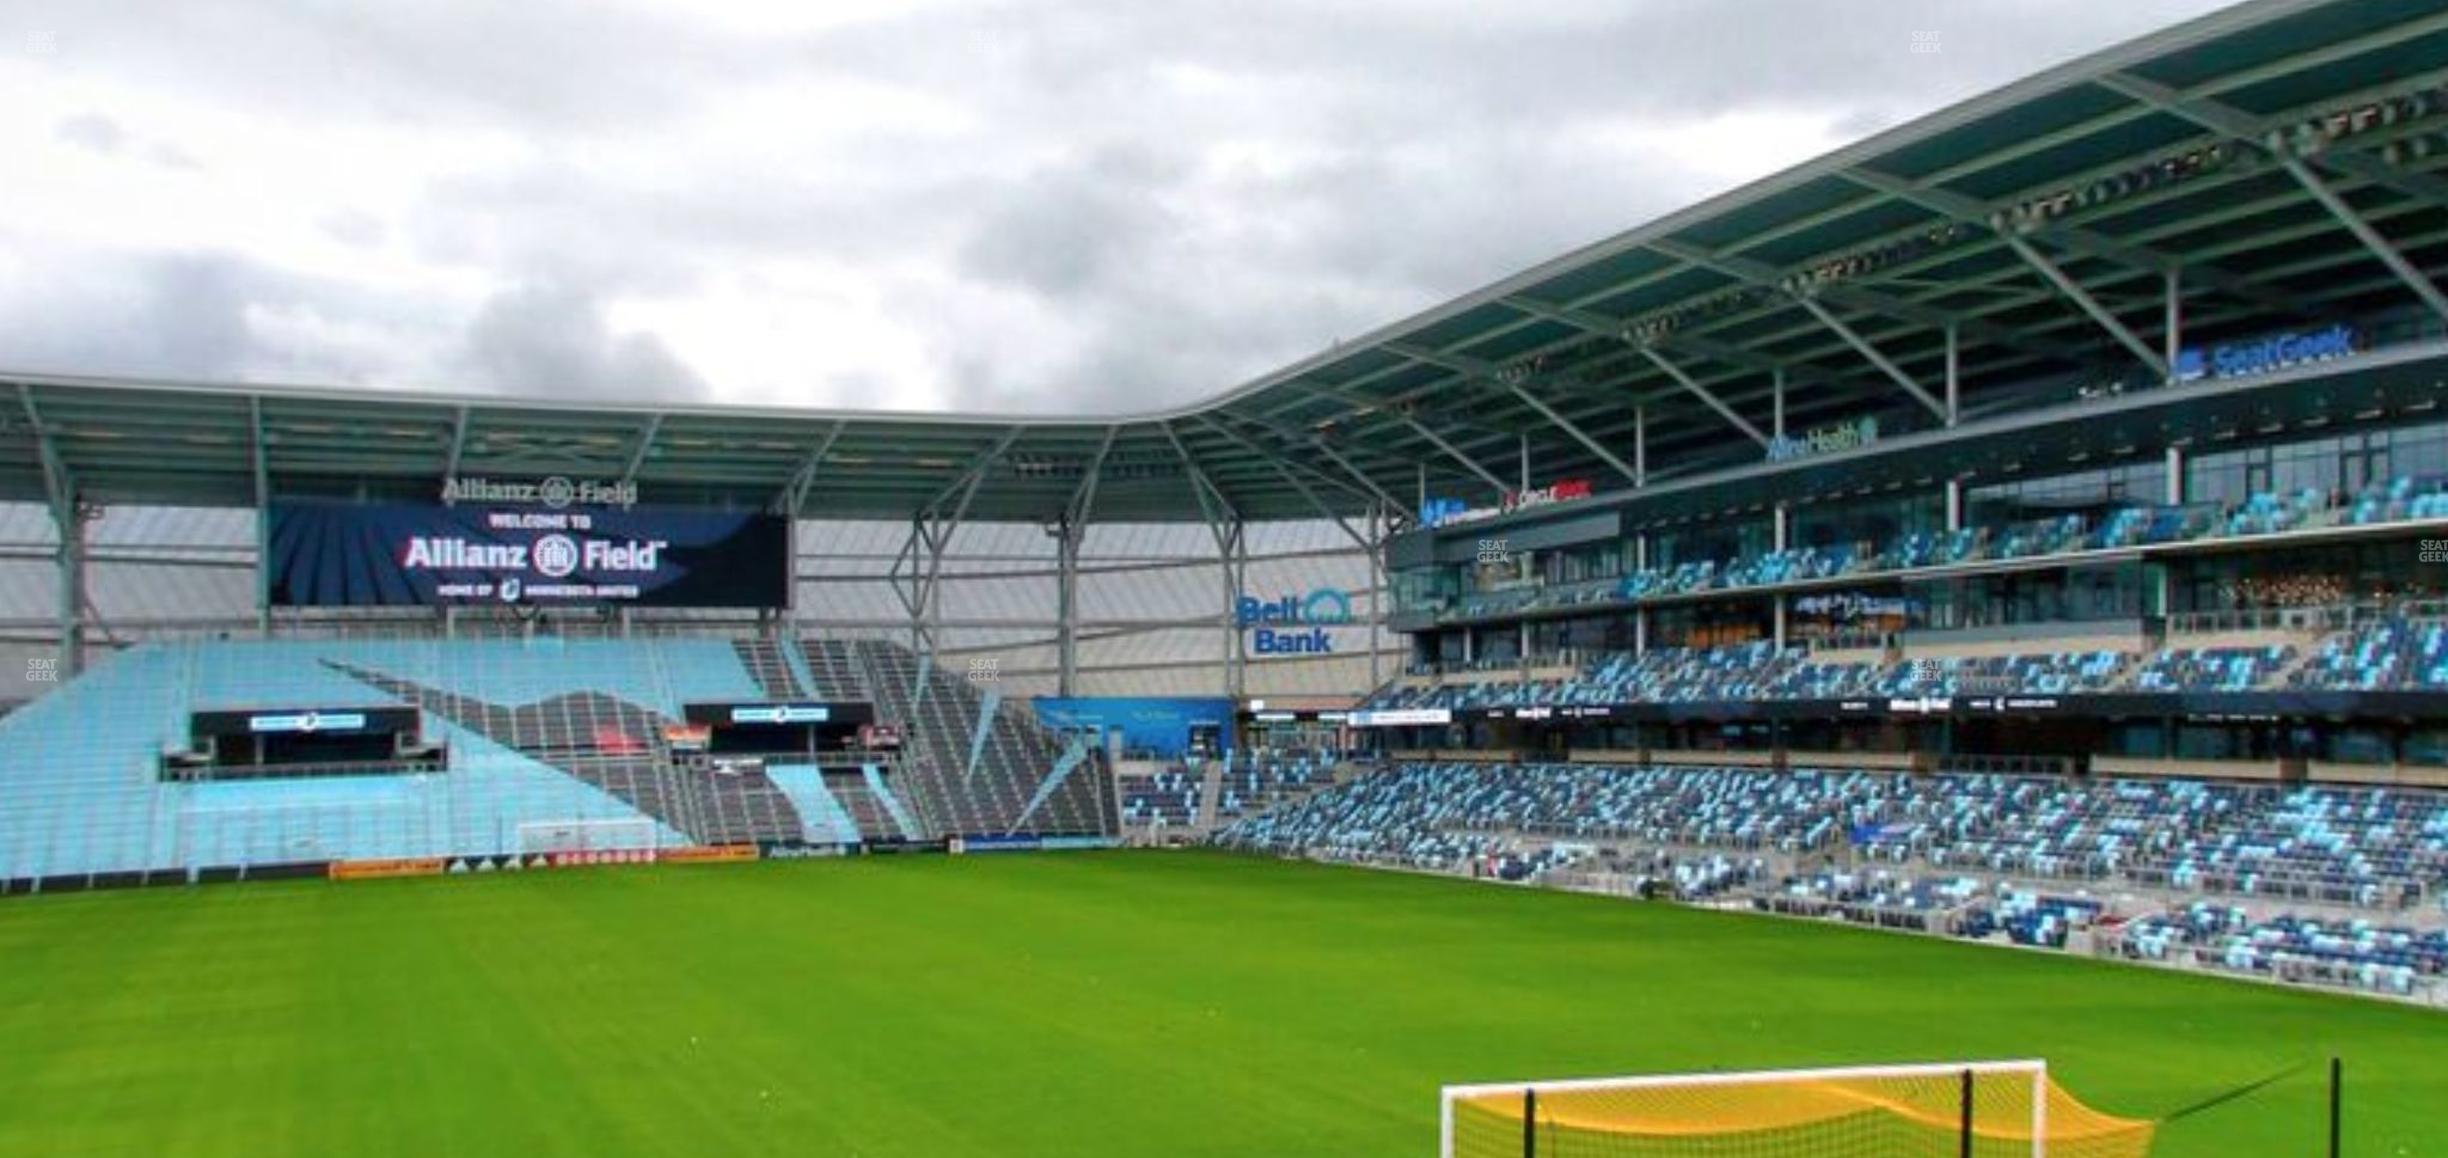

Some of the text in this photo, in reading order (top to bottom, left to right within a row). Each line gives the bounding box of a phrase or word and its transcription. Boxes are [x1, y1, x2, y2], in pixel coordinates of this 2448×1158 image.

[2213, 325, 2354, 376] SeatGeek
[442, 477, 638, 504] Allianz Field
[488, 513, 592, 529] WELCOME TO
[404, 536, 528, 568] Allianz
[1236, 596, 1298, 622] Bell
[1255, 626, 1332, 653] Bank
